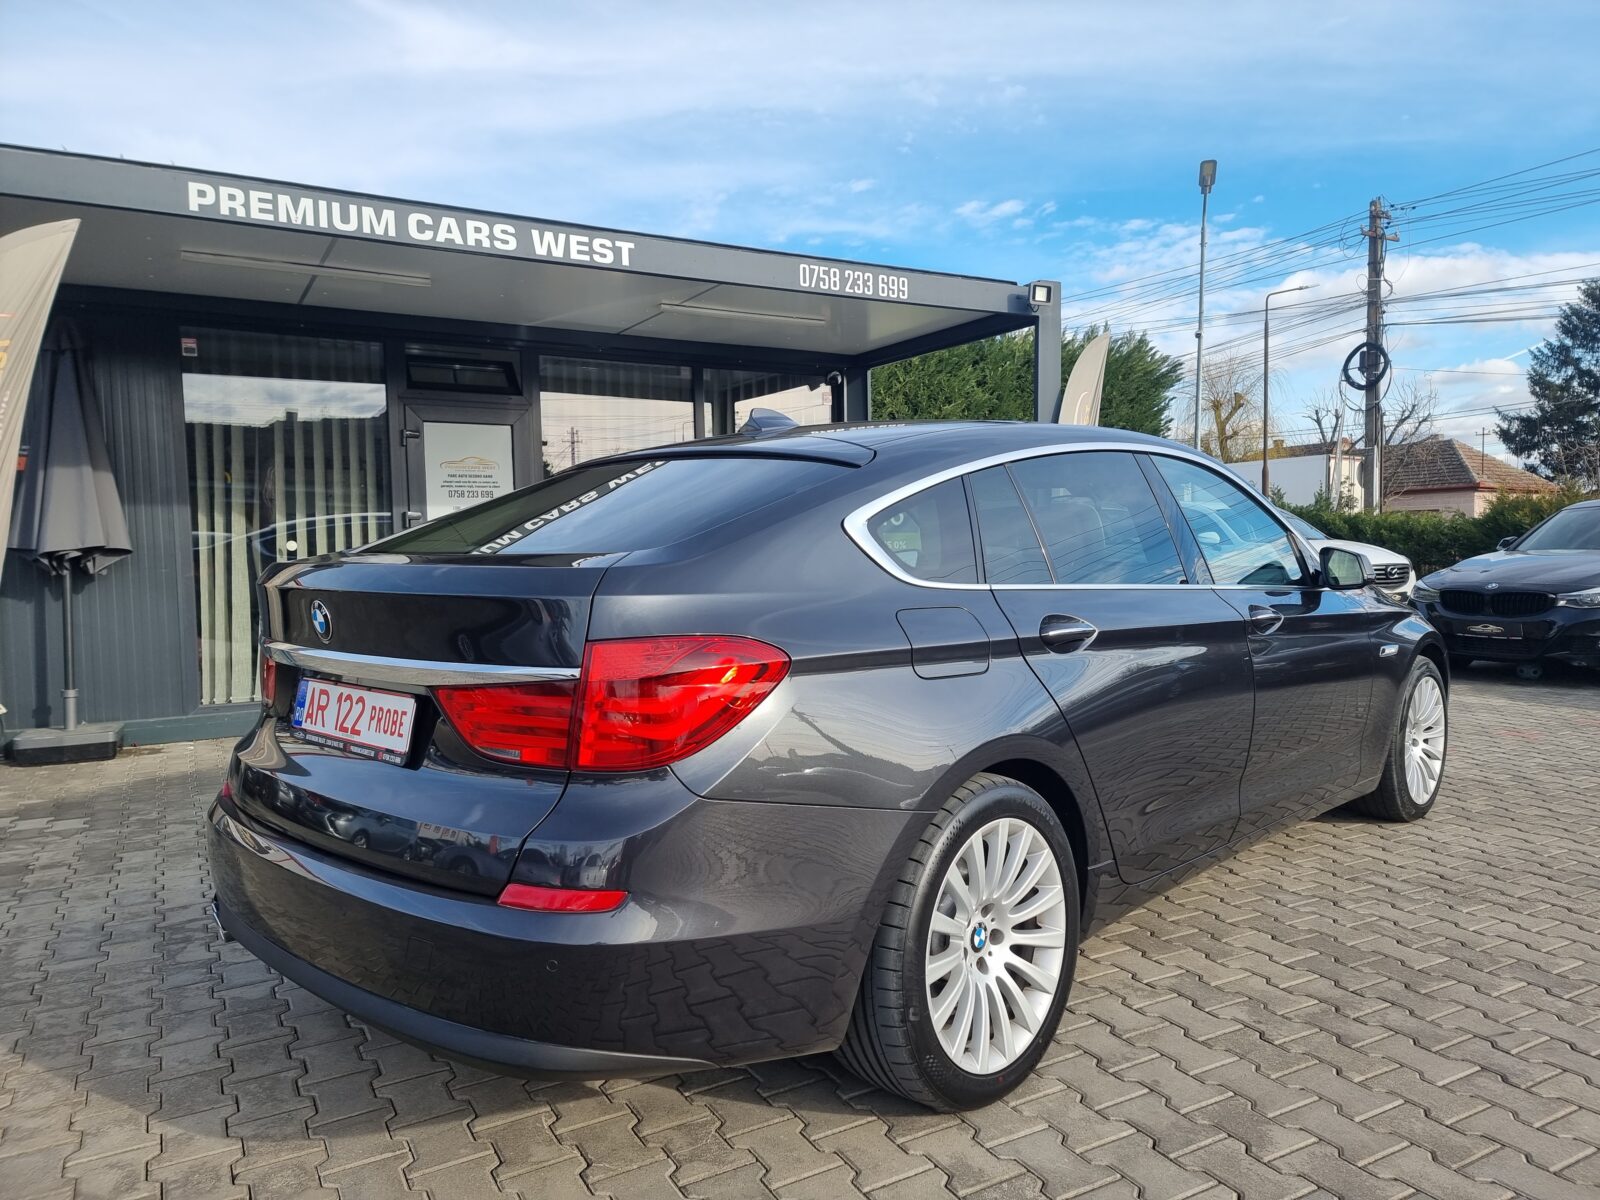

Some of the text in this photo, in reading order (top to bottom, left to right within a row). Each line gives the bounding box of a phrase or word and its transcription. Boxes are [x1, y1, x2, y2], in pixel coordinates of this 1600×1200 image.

[188, 181, 635, 267] PREMIUM CARS WEST
[799, 263, 908, 299] 0758 233 699
[448, 490, 494, 499] 0758 233 699
[294, 706, 304, 723] RO
[304, 687, 407, 738] AR 122 PROBE
